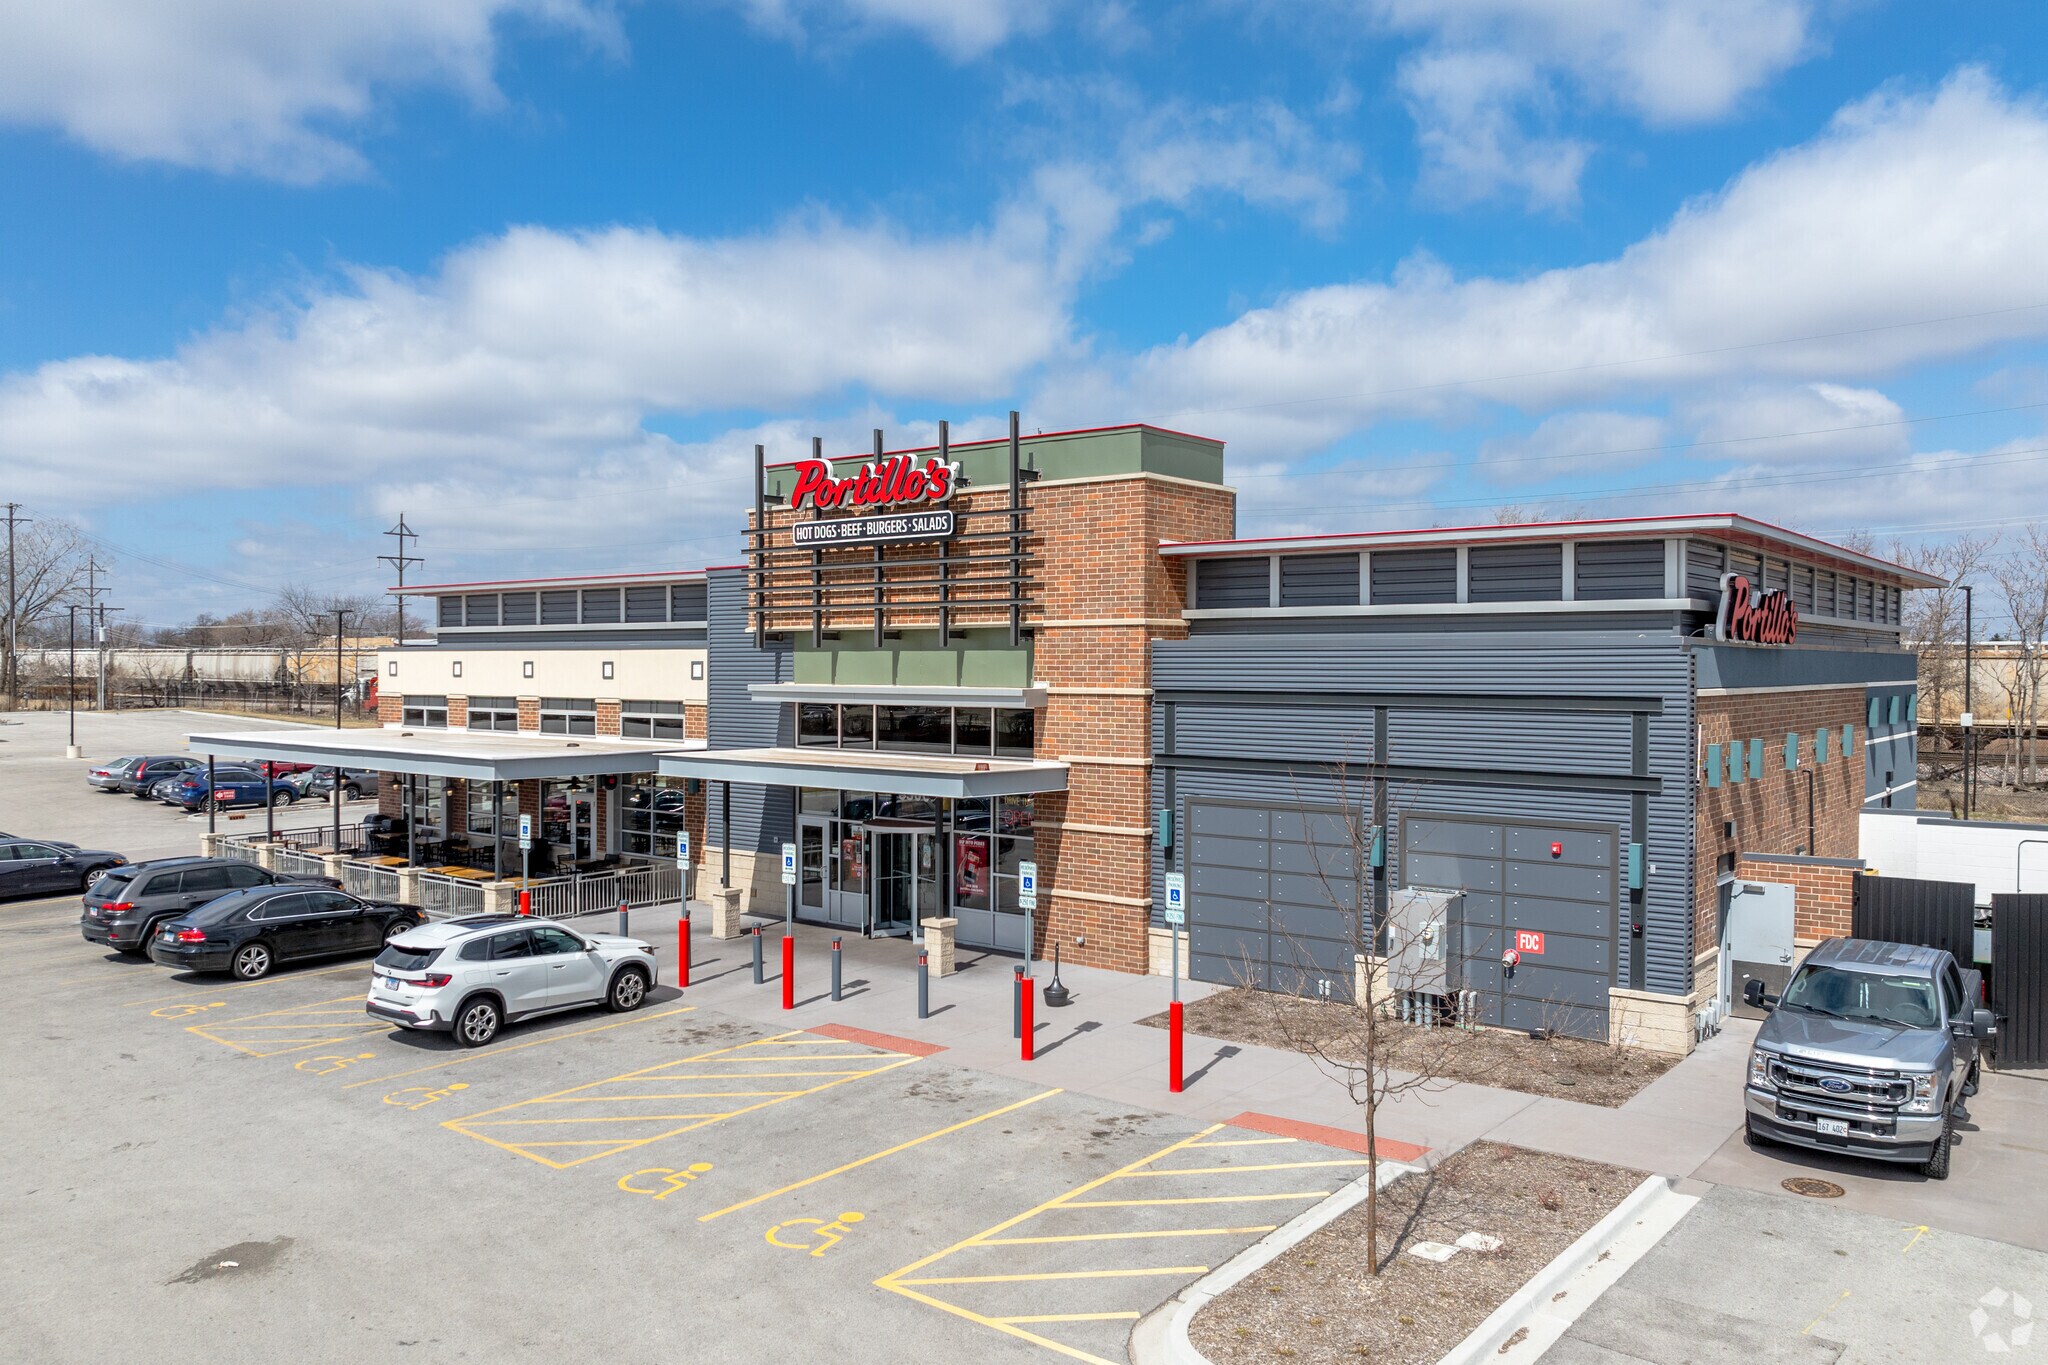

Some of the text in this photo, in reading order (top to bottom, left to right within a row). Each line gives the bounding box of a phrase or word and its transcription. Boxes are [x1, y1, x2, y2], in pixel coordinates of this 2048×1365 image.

[791, 454, 951, 511] Portillo's
[796, 516, 948, 541] HOT DOGS BEEF BURGERS SALADS
[1730, 576, 1798, 645] Portillo's
[1520, 933, 1539, 950] FDC
